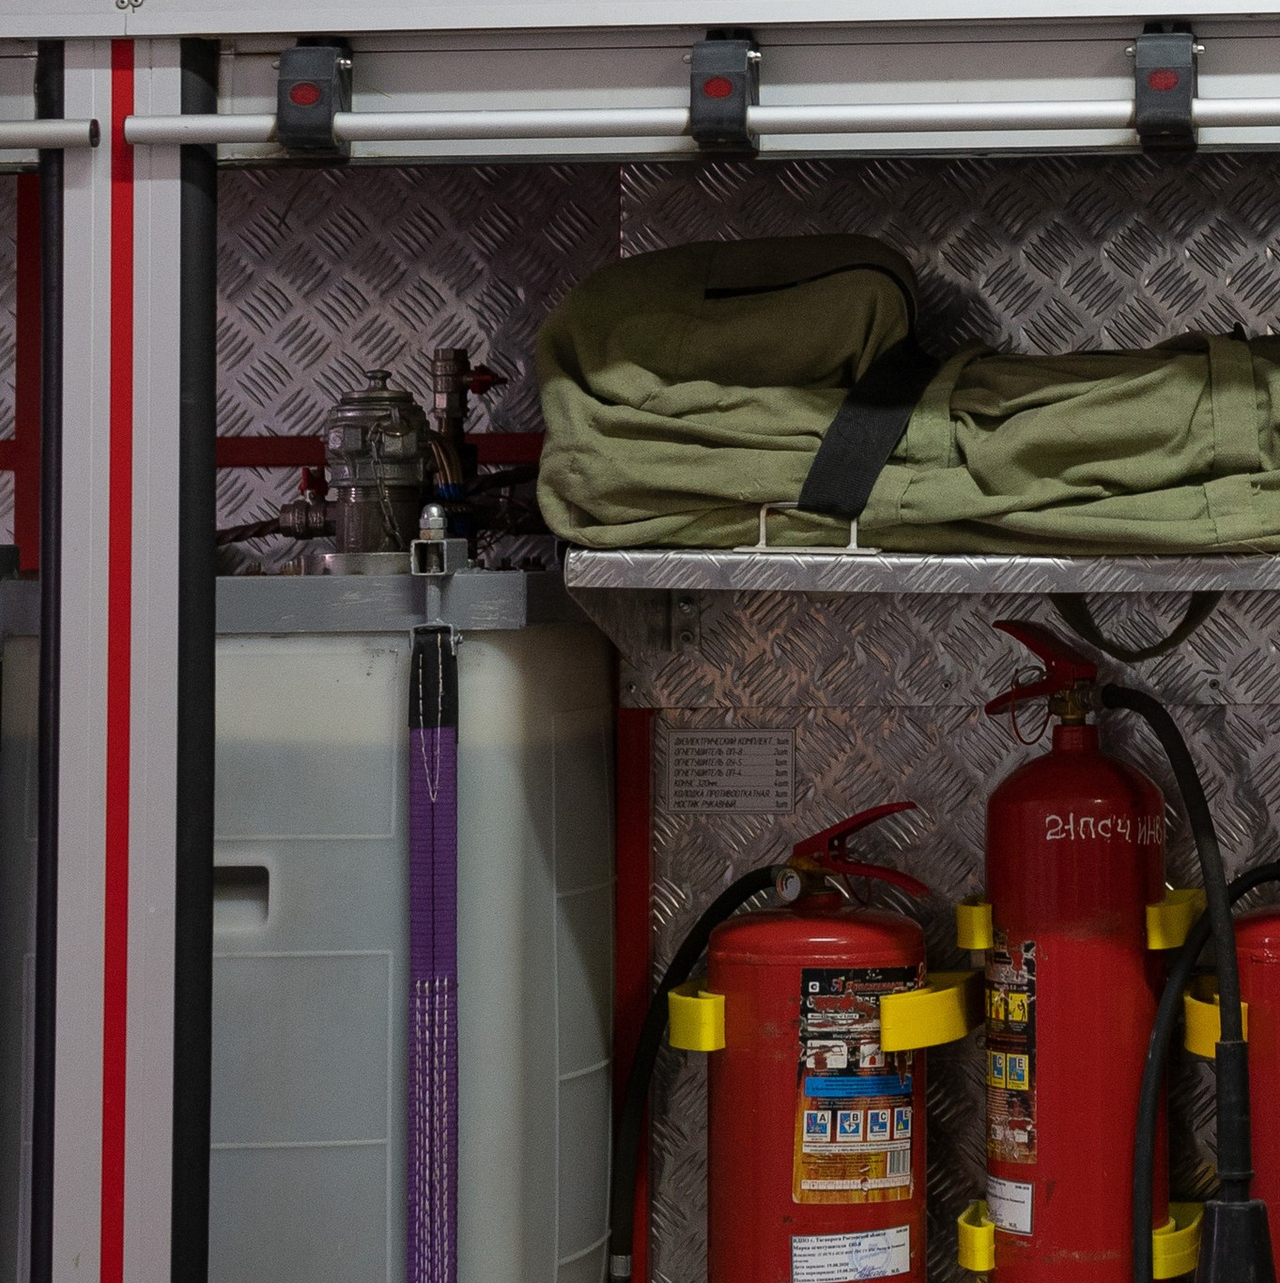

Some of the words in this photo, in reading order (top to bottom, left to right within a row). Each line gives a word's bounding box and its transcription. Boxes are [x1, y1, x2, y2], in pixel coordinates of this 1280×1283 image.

[674, 748, 724, 756] ОГНЕТУШИТЕЛЬ
[674, 769, 724, 777] ОГНЕТУШИТЕЛЬ
[1017, 1058, 1024, 1068] E
[819, 1113, 826, 1122] A
[852, 1113, 859, 1121] B
[880, 1112, 887, 1120] C
